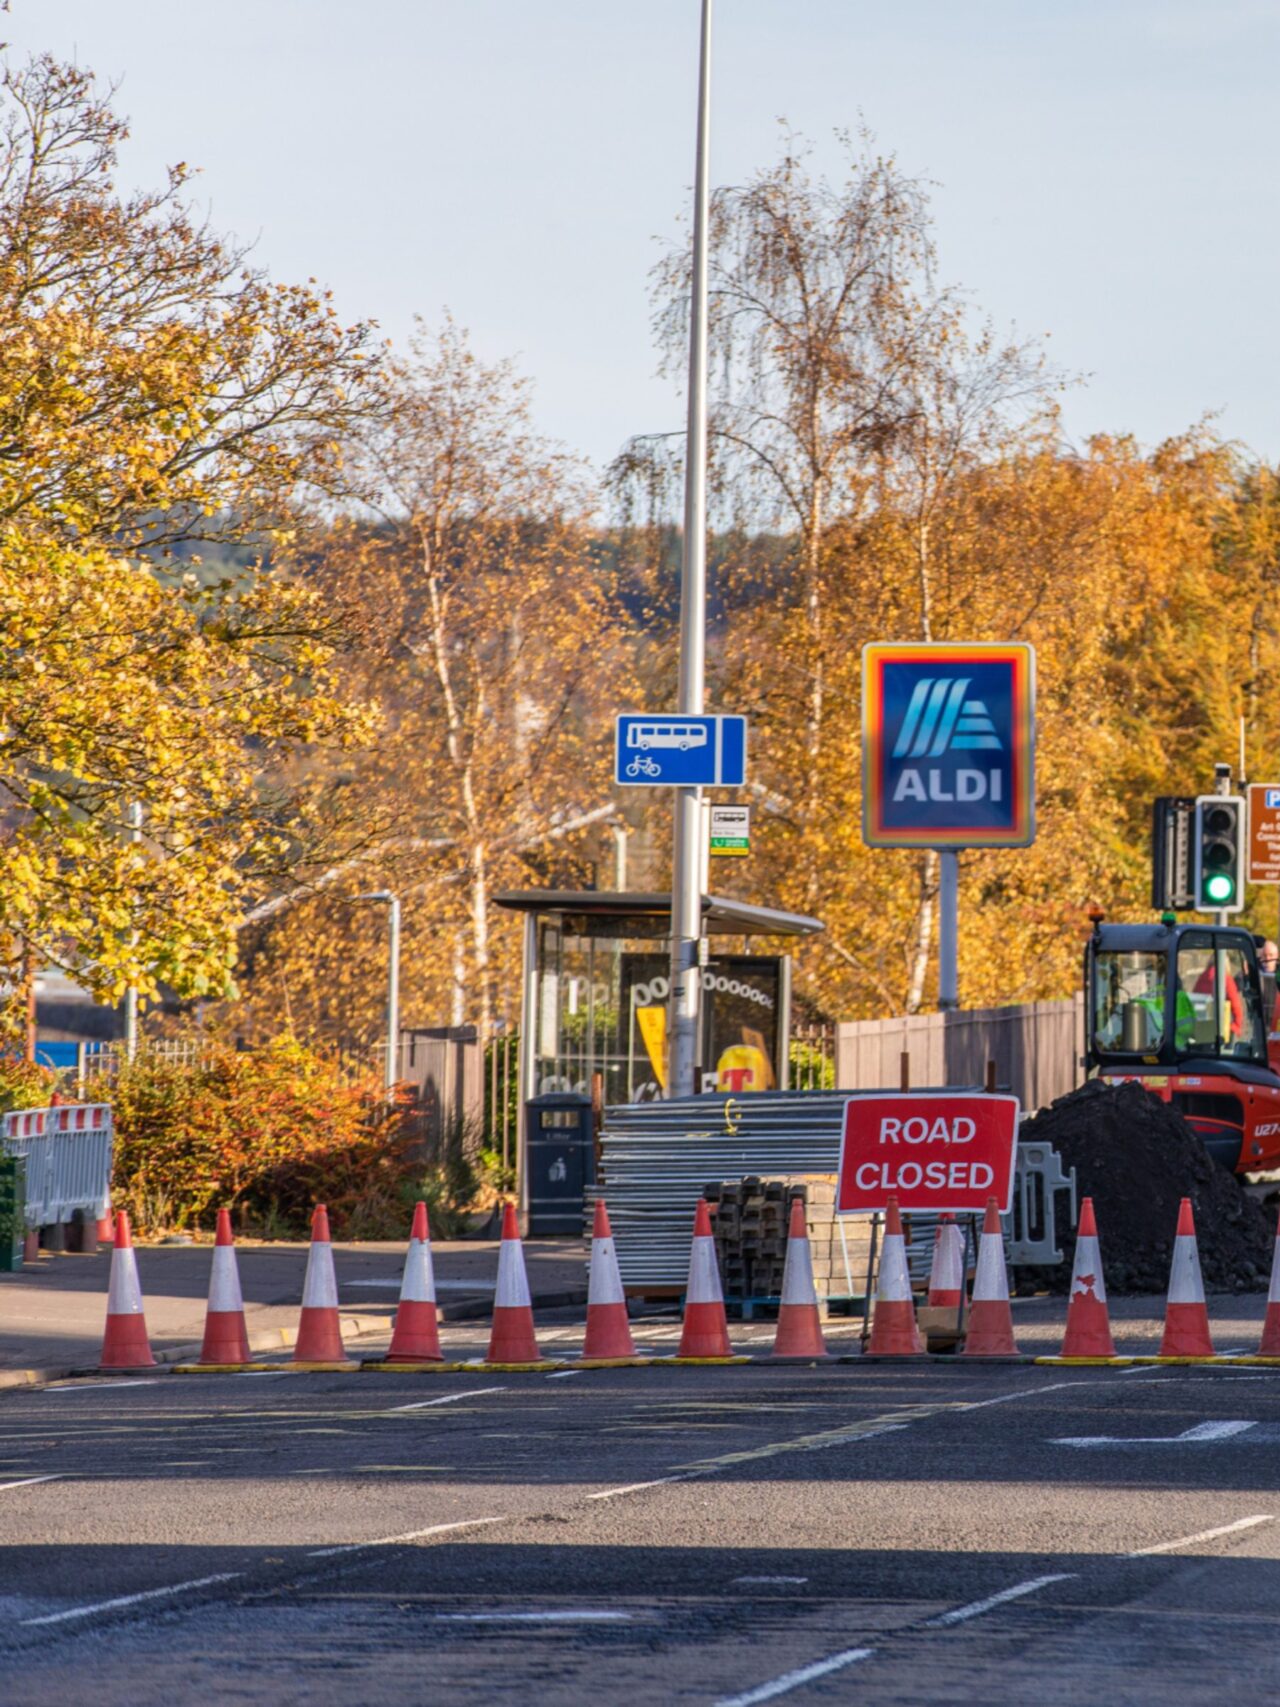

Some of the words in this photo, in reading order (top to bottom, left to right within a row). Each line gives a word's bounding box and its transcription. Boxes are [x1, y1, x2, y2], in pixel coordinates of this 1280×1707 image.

[892, 768, 1002, 802] ALDI
[1260, 822, 1274, 832] Art
[879, 1116, 977, 1144] ROAD
[855, 1161, 994, 1190] CLOSED
